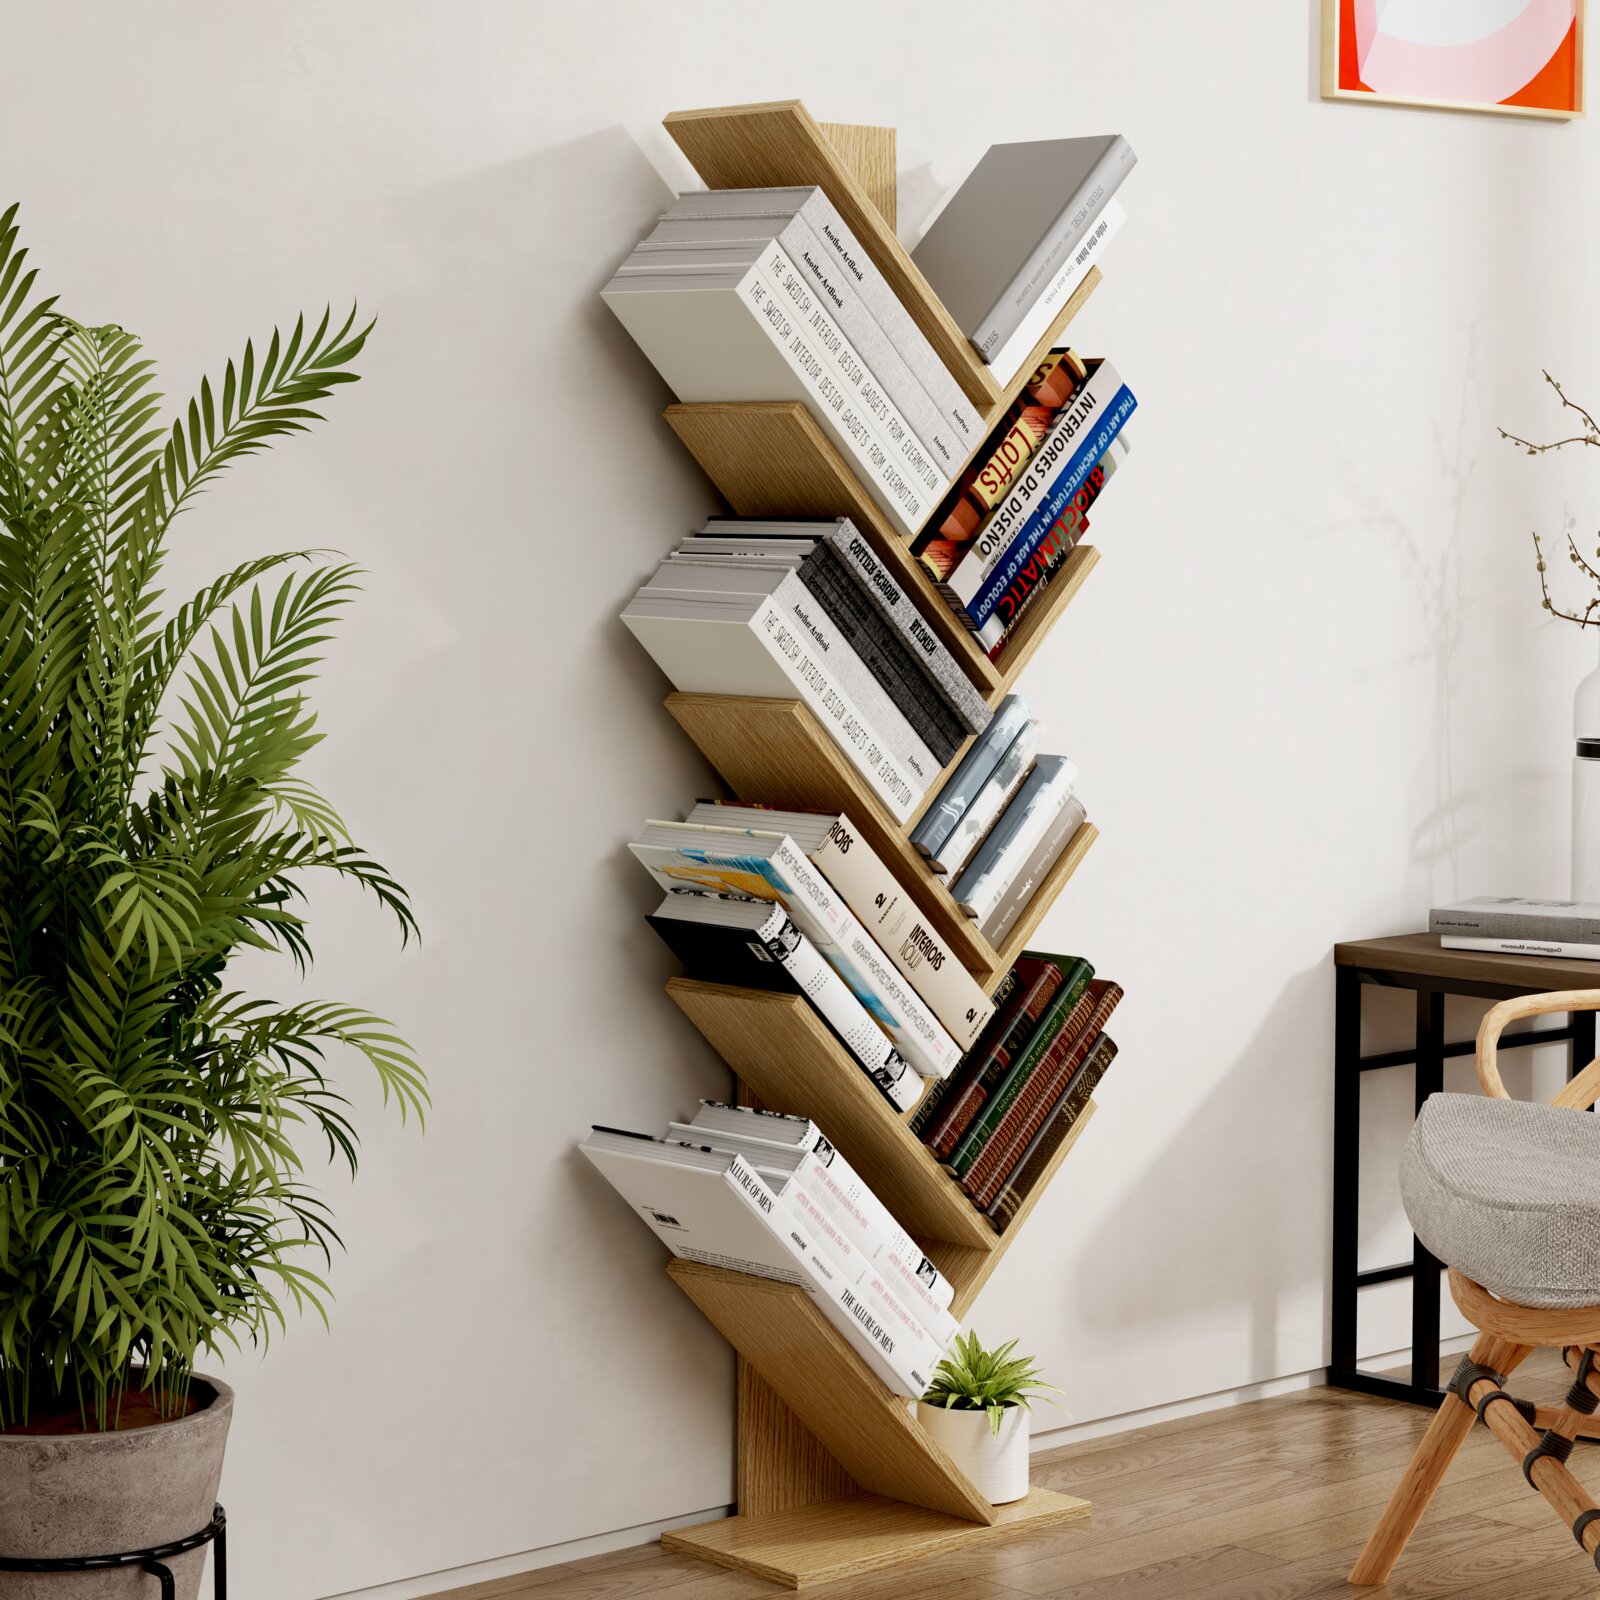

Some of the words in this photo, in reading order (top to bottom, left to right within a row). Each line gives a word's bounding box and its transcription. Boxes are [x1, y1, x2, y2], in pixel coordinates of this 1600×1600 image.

[1094, 220, 1108, 238] ride
[822, 224, 844, 254] Another
[841, 250, 863, 282] ArtBook
[1085, 234, 1098, 250] the
[1074, 246, 1090, 266] bike
[801, 251, 824, 281] Another
[820, 277, 843, 309] ArtBook
[1056, 275, 1066, 290] and
[1044, 287, 1058, 305] tricks
[768, 253, 786, 279] THE
[781, 272, 812, 315] SWEDISH
[807, 309, 842, 356] INTERIOR
[836, 349, 864, 387] DESIGN
[859, 380, 890, 422] GADGETS
[885, 415, 906, 444] FROM
[900, 437, 940, 491] EVERMOTION
[748, 280, 766, 305] THE
[761, 299, 793, 341] SWEDISH
[788, 335, 822, 382] INTERIOR
[817, 375, 845, 413] DESIGN
[840, 406, 870, 448] GADGETS
[866, 441, 886, 470] FROM
[882, 463, 920, 517] EVERMOTION
[1117, 394, 1134, 417] THE
[951, 408, 969, 434] EverPress
[1105, 411, 1121, 435] ART
[1033, 390, 1096, 479] INTERIORES
[1096, 430, 1108, 449] OF
[932, 435, 950, 461] EverPress
[1017, 473, 1038, 501] DE
[1048, 443, 1099, 515] ARCHITECTURE
[977, 496, 1023, 558] DISEÑO
[1017, 516, 1025, 527] LA
[1040, 510, 1052, 526] IN
[1001, 466, 1105, 617] BIOCLIMATIC
[1006, 525, 1019, 543] CASA
[1027, 522, 1045, 546] THE
[989, 542, 1007, 567] ACTUAL
[1013, 540, 1031, 565] AGE
[1005, 560, 1017, 579] OF
[974, 574, 1008, 621] ECOLOGY
[792, 603, 812, 629] Another
[808, 624, 830, 653] ArtBook
[761, 608, 779, 633] THE
[773, 624, 801, 662] SWEDISH
[796, 654, 827, 696] INTERIOR
[821, 687, 847, 722] DESIGN
[841, 713, 869, 751] GADGETS
[863, 742, 883, 769] FROM
[877, 760, 912, 808] EVERMOTION
[784, 853, 795, 866] OF
[789, 859, 803, 878] THE
[796, 869, 813, 890] 20TH
[807, 882, 831, 912] CENTURY
[874, 891, 886, 908] 2
[898, 938, 923, 972] NOW!
[908, 923, 945, 971] INTERIORS
[850, 938, 872, 964] VISIONARY
[867, 957, 897, 996] ARCHITECTURE
[891, 987, 903, 1001] OF
[897, 994, 910, 1011] THE
[904, 1003, 919, 1023] 20TH
[913, 1015, 937, 1044] CENTURY
[965, 1007, 977, 1023] 2
[726, 1159, 753, 1190] ALLURE
[748, 1183, 761, 1198] OF
[757, 1192, 773, 1213] MEN
[840, 1289, 855, 1308] THE
[851, 1302, 876, 1332] ALLURE
[870, 1324, 884, 1340] OF
[879, 1332, 895, 1354] MEN
